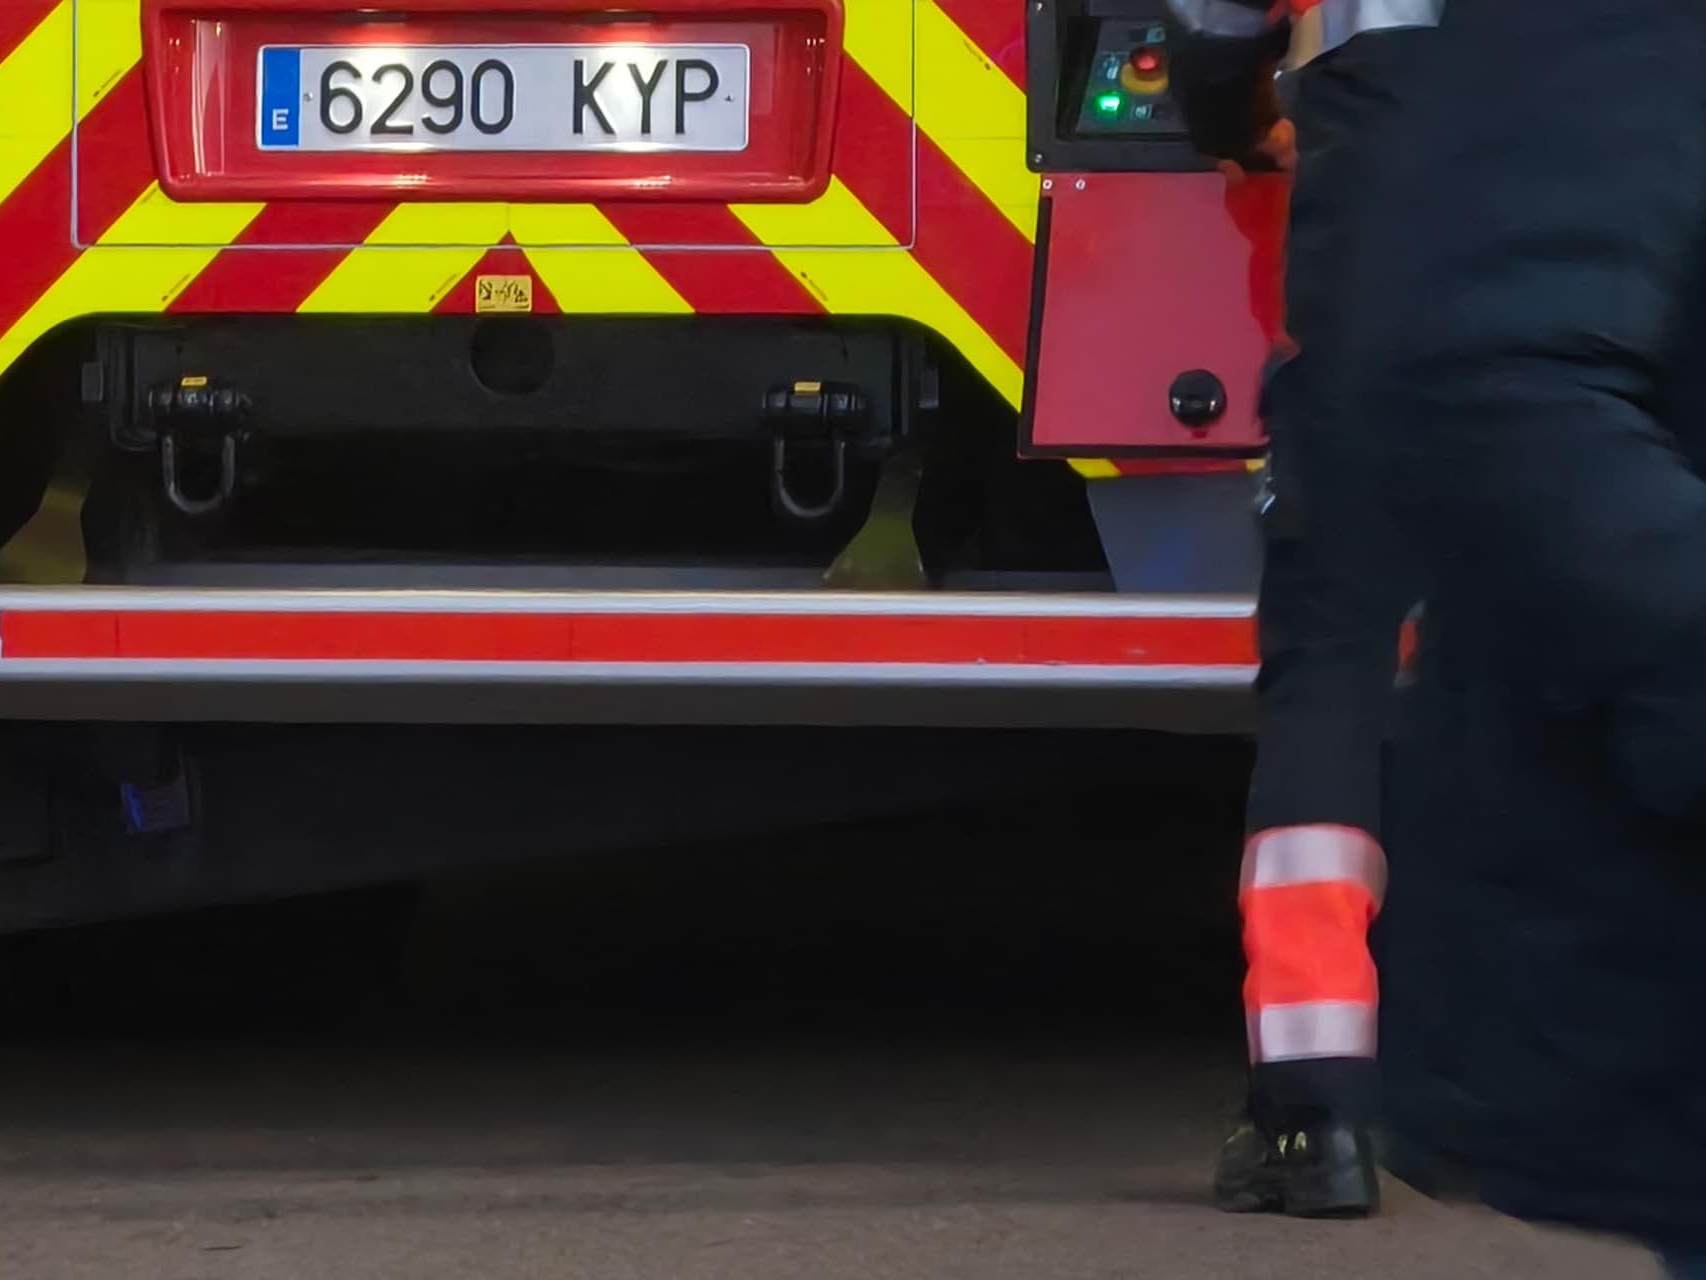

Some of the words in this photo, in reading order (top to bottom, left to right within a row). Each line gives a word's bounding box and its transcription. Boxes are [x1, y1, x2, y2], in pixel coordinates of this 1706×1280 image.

[271, 108, 289, 131] E
[318, 58, 515, 136] 6290
[572, 58, 720, 135] KYP
